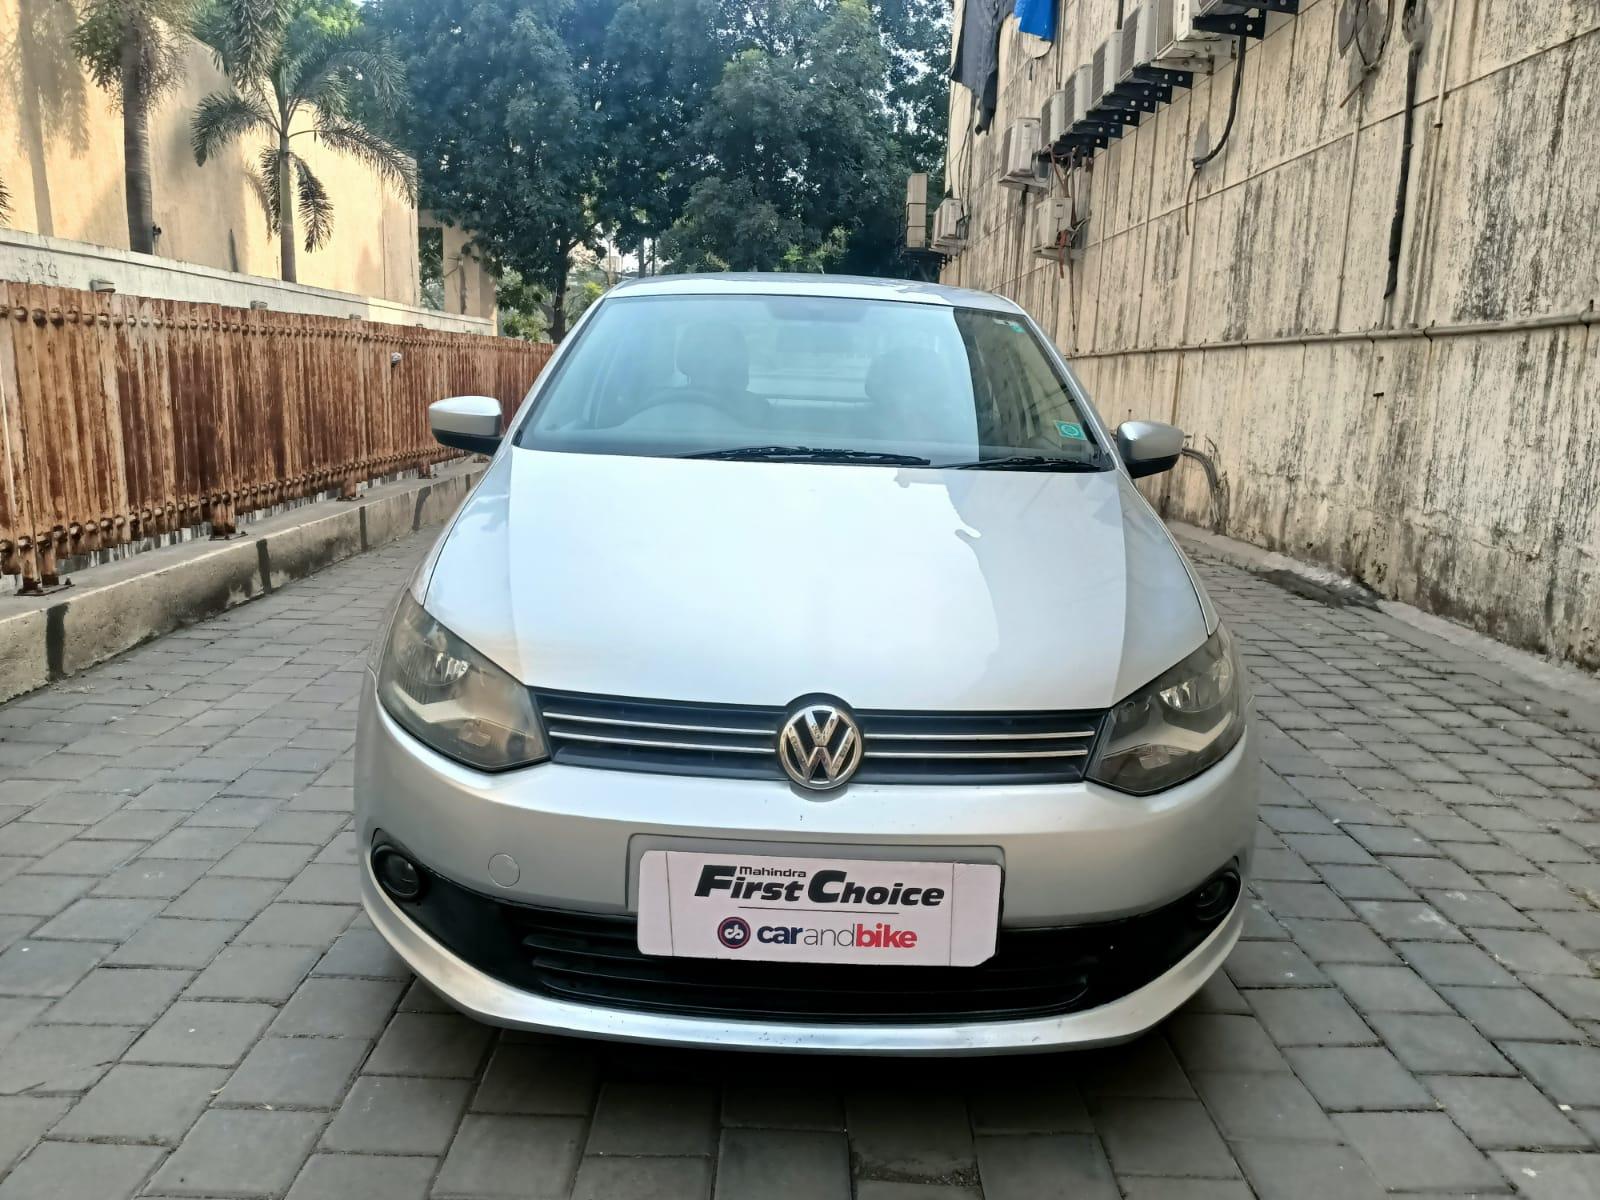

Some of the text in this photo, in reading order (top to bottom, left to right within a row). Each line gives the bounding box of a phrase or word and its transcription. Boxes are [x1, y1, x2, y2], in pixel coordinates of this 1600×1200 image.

[694, 864, 945, 907] First Choice
[739, 865, 807, 879] Mahindra
